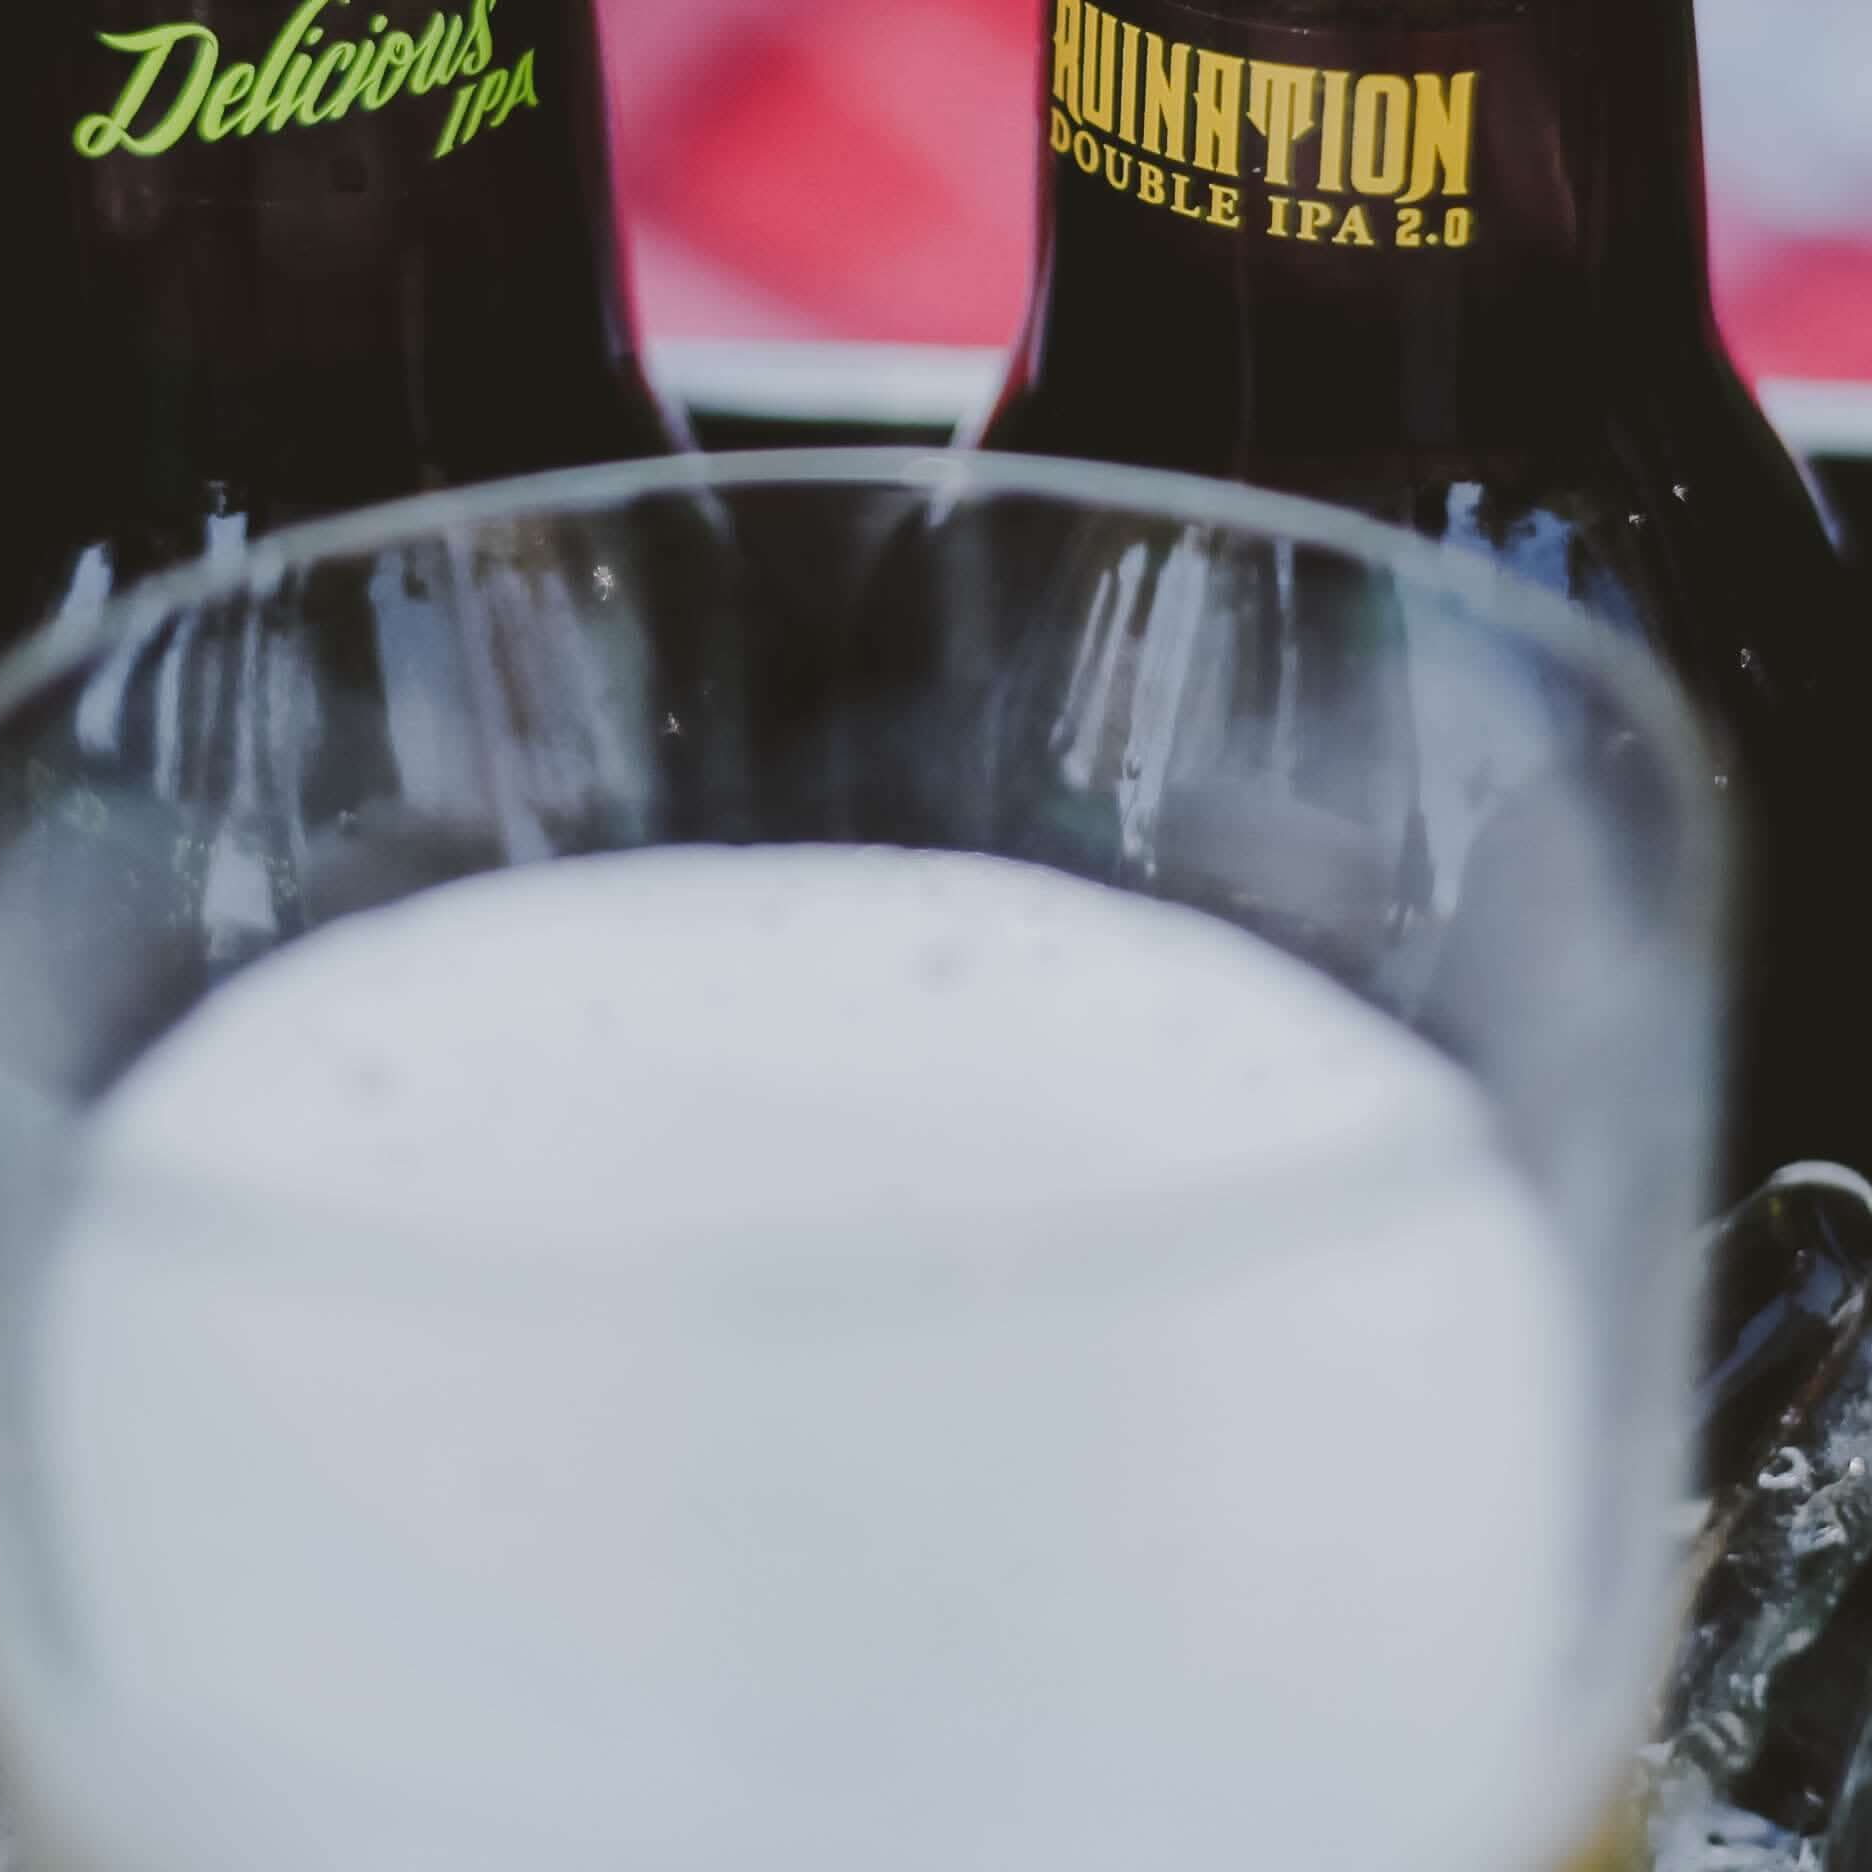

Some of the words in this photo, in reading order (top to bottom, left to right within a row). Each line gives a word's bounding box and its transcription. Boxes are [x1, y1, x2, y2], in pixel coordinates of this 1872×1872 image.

[433, 48, 539, 159] IPA
[1049, 106, 1241, 228] DOUBLE
[1266, 195, 1374, 246] IPA
[1395, 206, 1472, 248] 2.0
